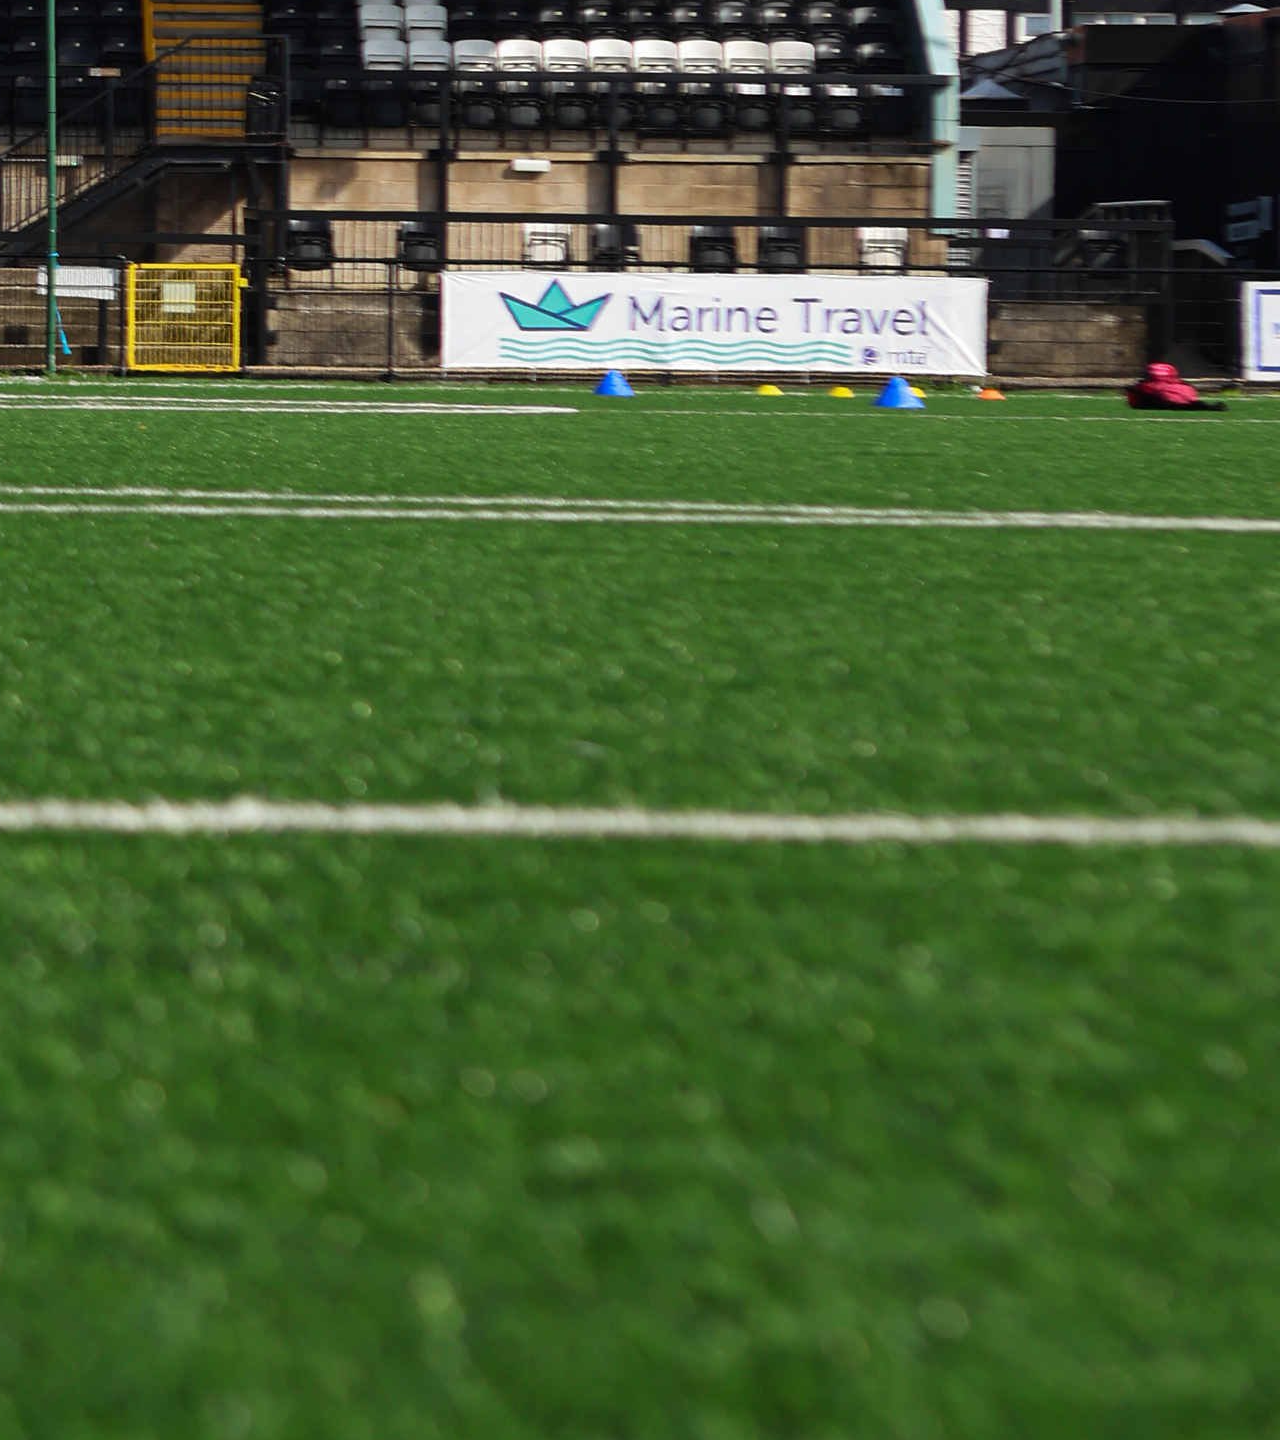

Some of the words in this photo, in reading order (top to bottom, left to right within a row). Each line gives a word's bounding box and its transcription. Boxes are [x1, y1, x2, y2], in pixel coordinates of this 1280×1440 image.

[627, 295, 779, 333] Marine
[792, 298, 931, 337] Travel
[886, 349, 926, 366] mta
